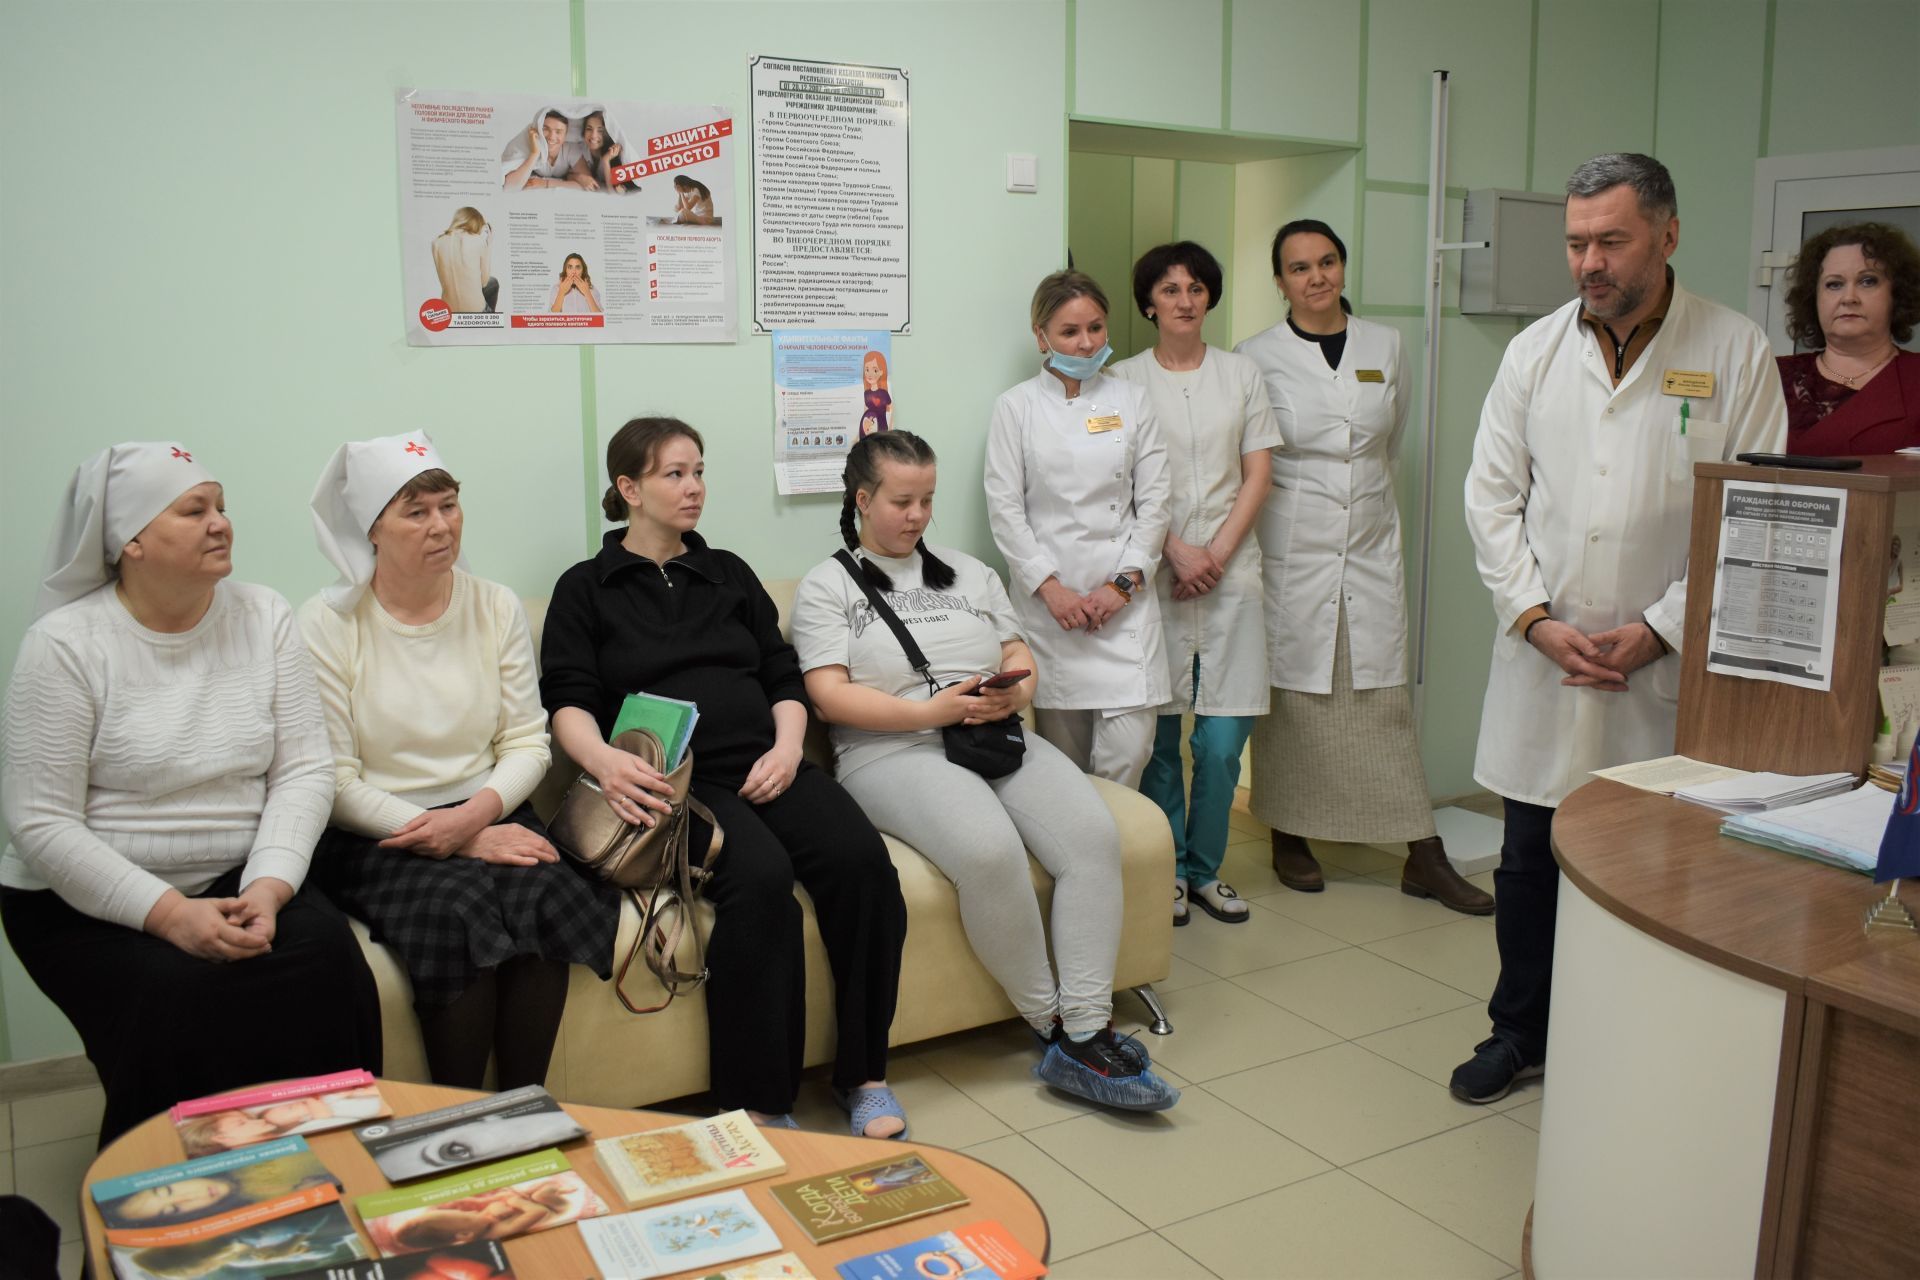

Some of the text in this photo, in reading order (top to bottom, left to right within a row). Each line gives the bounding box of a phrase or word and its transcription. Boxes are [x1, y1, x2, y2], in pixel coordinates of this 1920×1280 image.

[777, 111, 853, 124] ПЕРВООЧЕРЕДНОМ
[855, 117, 895, 127] ПОРЯДКЕ:
[652, 124, 719, 151] ЗАЩИТА
[616, 146, 714, 182] ЭТО ПРОСТО
[786, 236, 851, 245] ВНЕОЧЕРЕДНОМ
[854, 238, 891, 246] ПОРЯДКЕ
[1733, 496, 1830, 511] ГРАЖДАНСКАЯ ОБОРОНА
[925, 615, 950, 623] COAST
[826, 1176, 870, 1204] ДЕТИ
